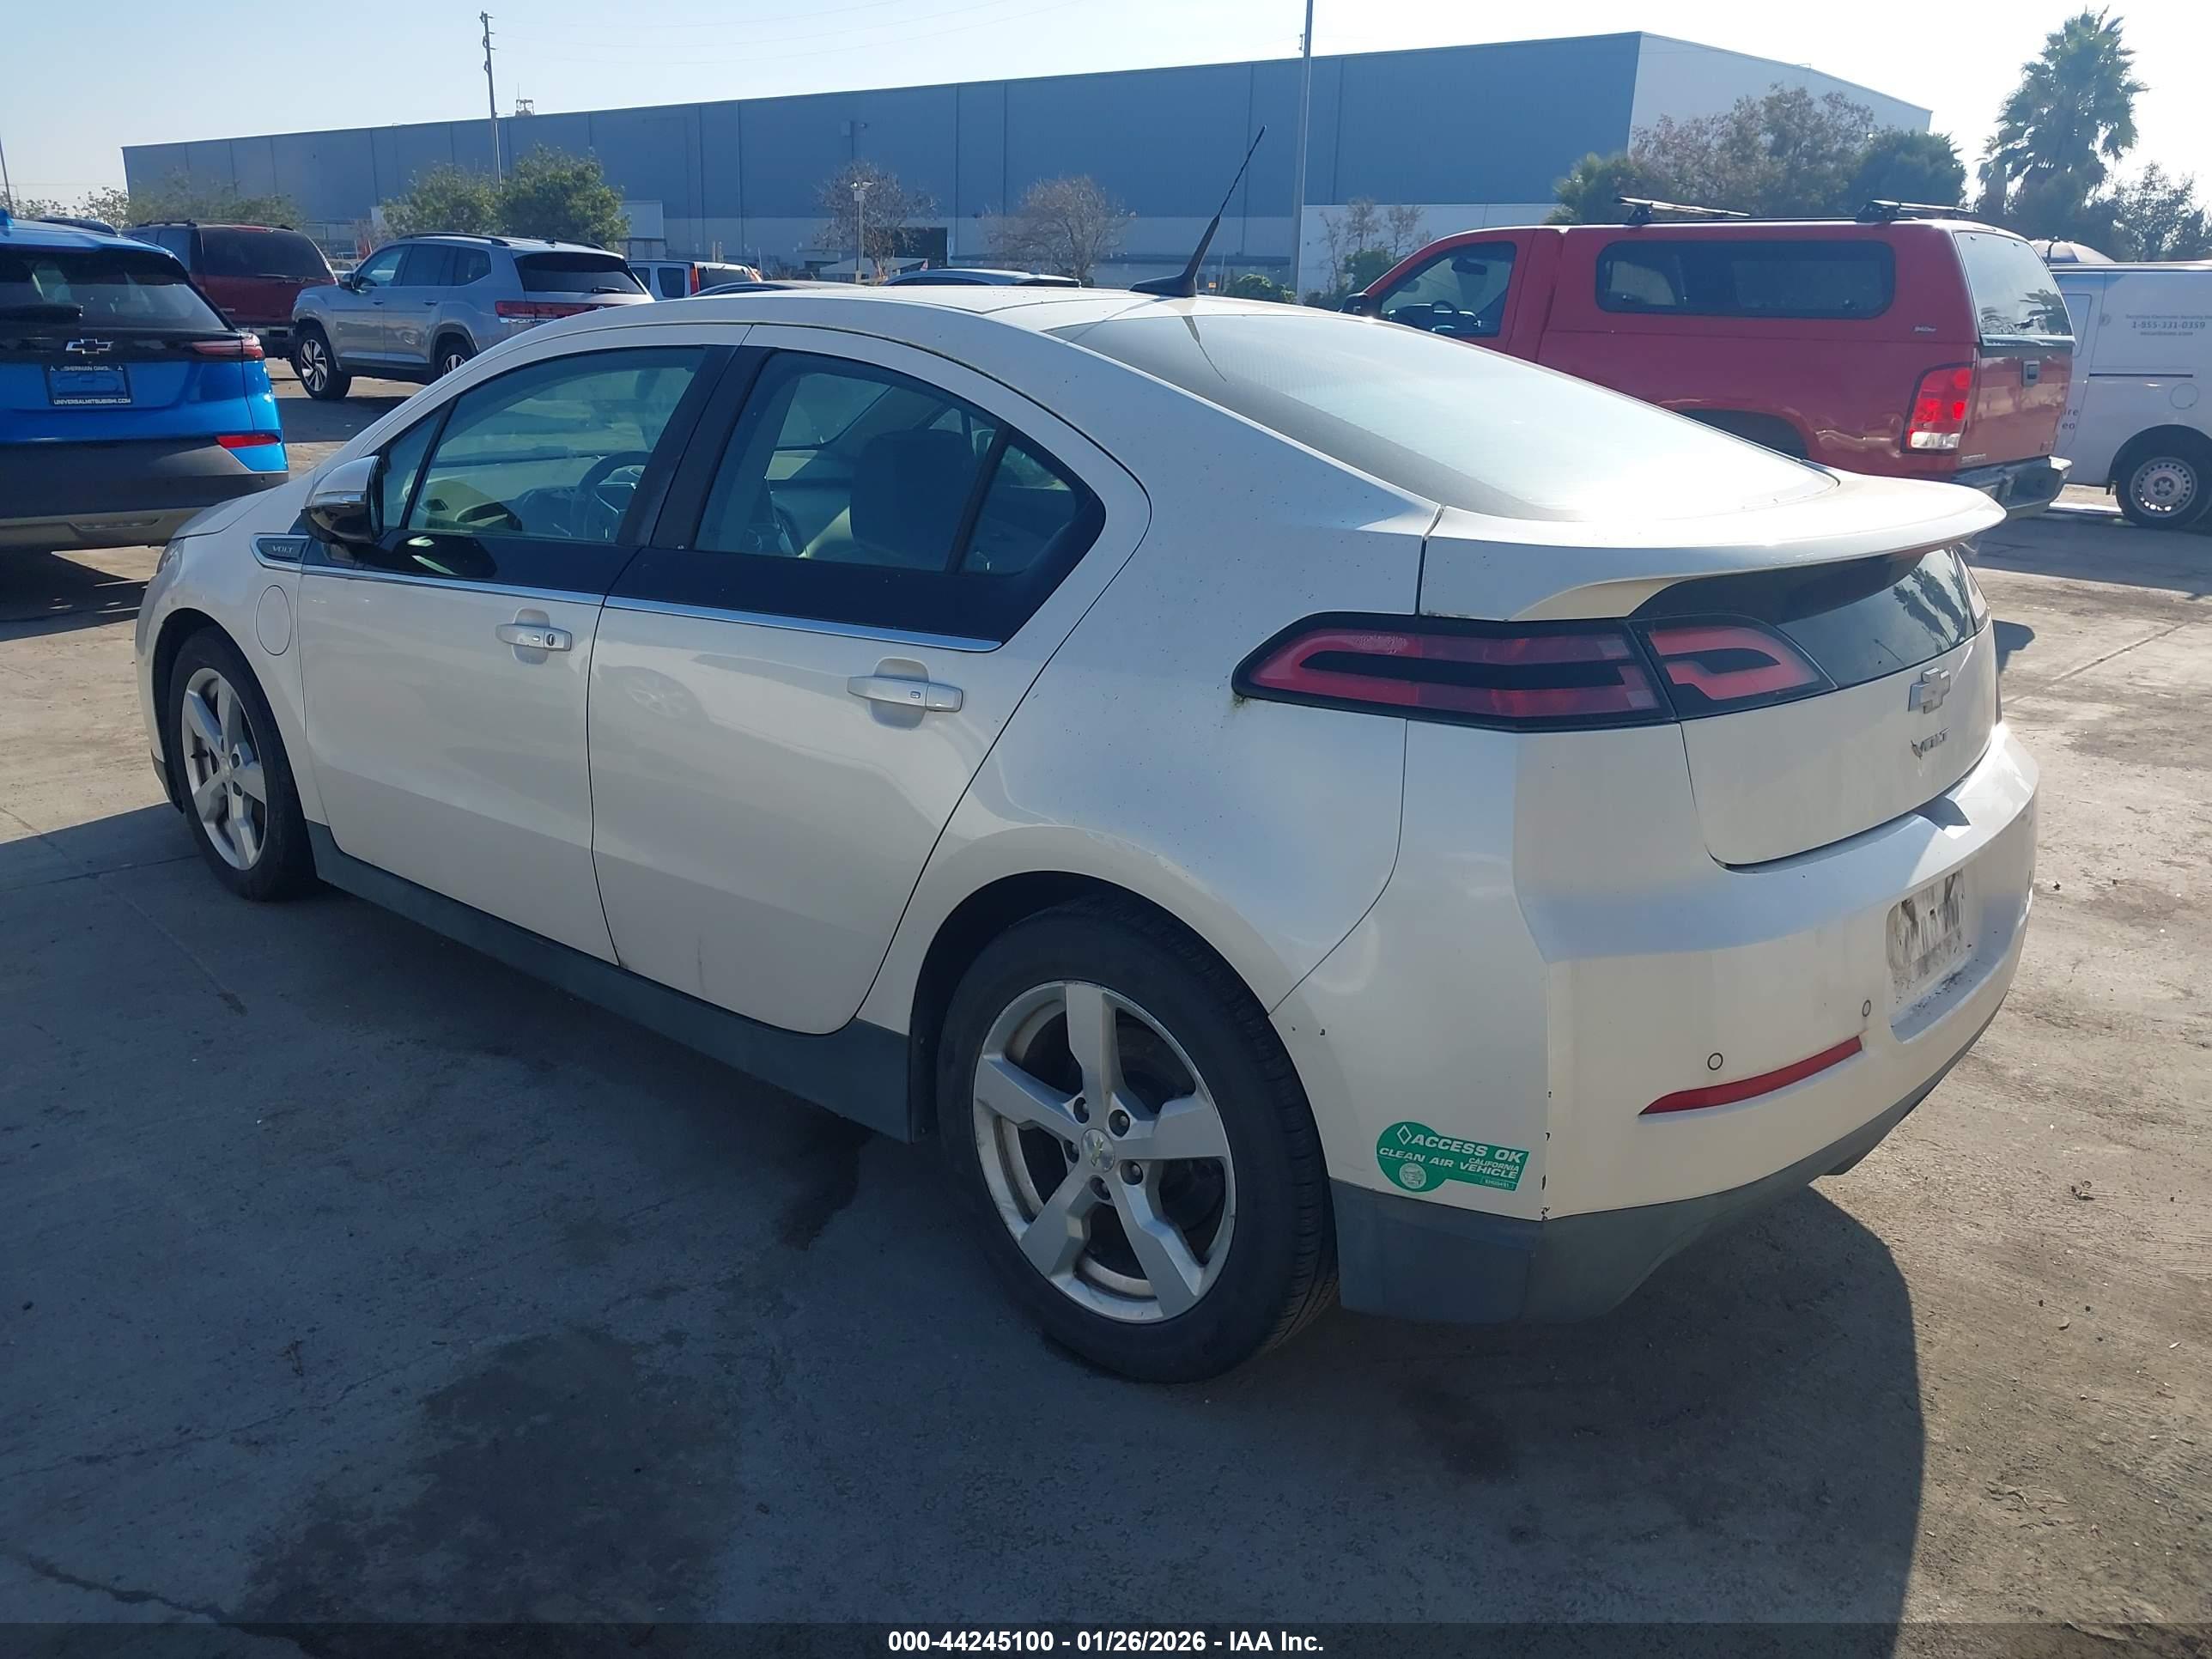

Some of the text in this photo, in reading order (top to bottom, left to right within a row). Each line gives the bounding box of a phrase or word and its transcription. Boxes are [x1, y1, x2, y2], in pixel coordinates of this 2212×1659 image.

[272, 545, 293, 554] VOLT
[1911, 727, 1950, 760] VOLT
[1379, 1147, 1518, 1179] CLEAN AIR VEHICLE
[1411, 1133, 1525, 1164] ACCESS OK
[1468, 1158, 1519, 1172] CALIFORNIA
